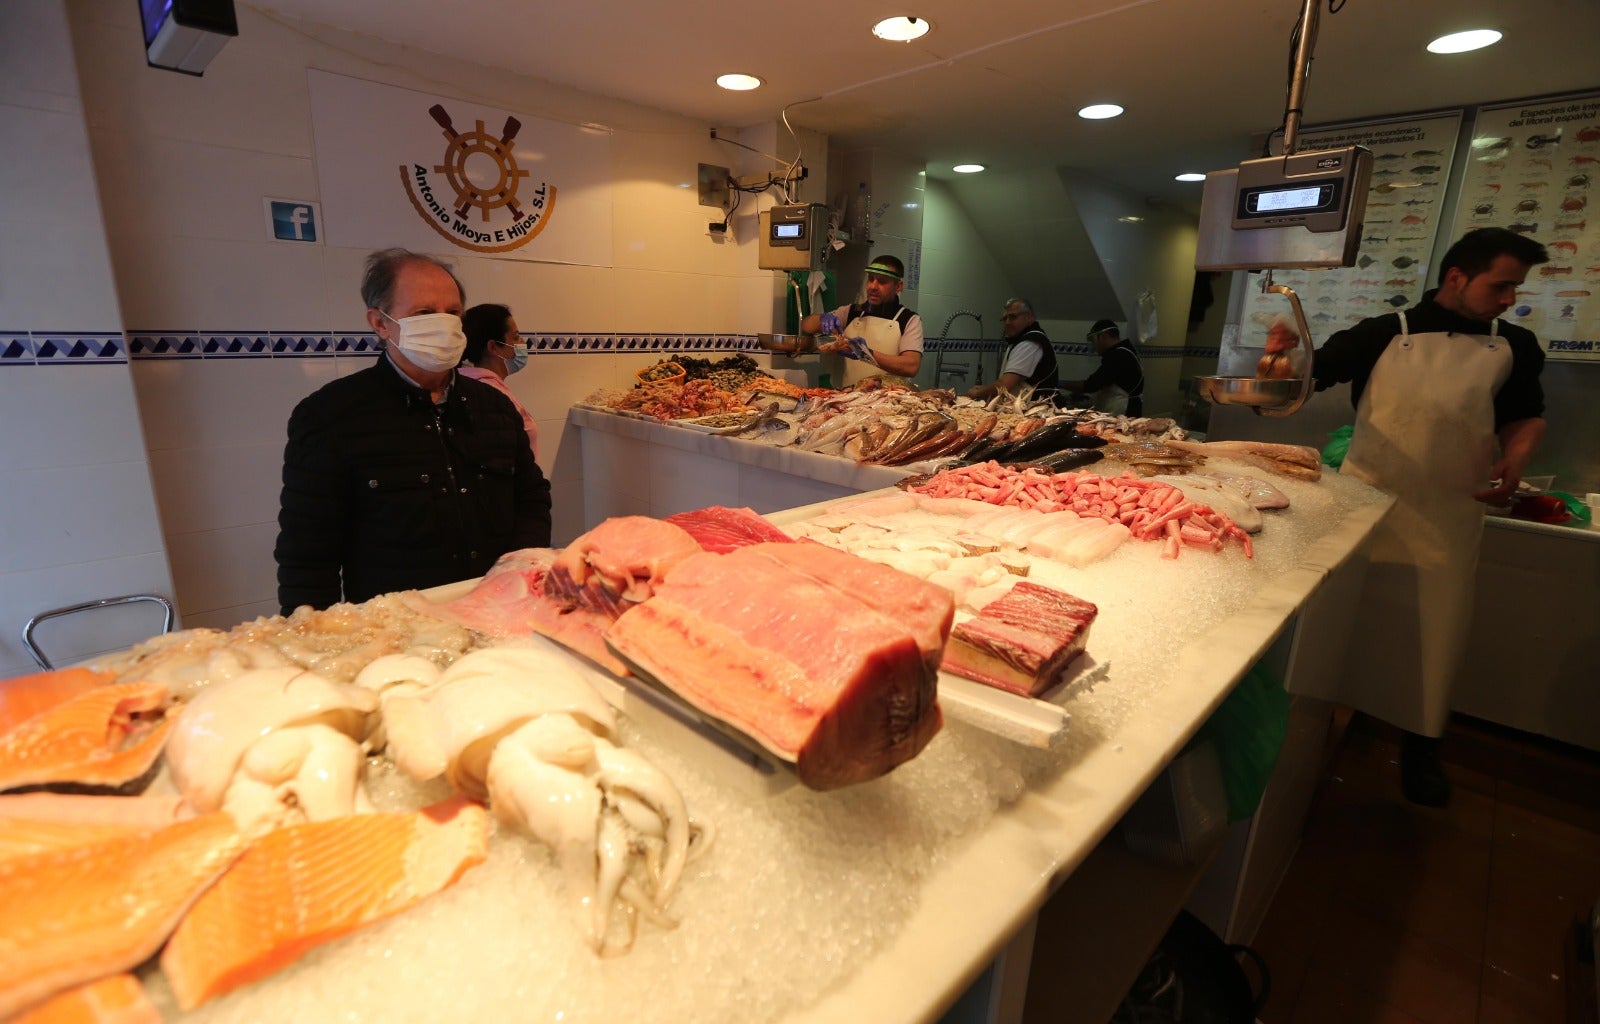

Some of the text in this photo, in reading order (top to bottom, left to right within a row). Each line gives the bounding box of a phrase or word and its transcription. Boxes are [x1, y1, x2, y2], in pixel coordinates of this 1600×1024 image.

[1508, 110, 1597, 128] del litoral español
[1520, 107, 1566, 118] Especies
[1567, 104, 1580, 112] de
[1301, 126, 1421, 146] Especies de interés económico
[1366, 134, 1415, 146] Vertebrados
[414, 163, 546, 243] Antonio Moya E Hijos, S.L.
[1548, 340, 1593, 350] FROM
